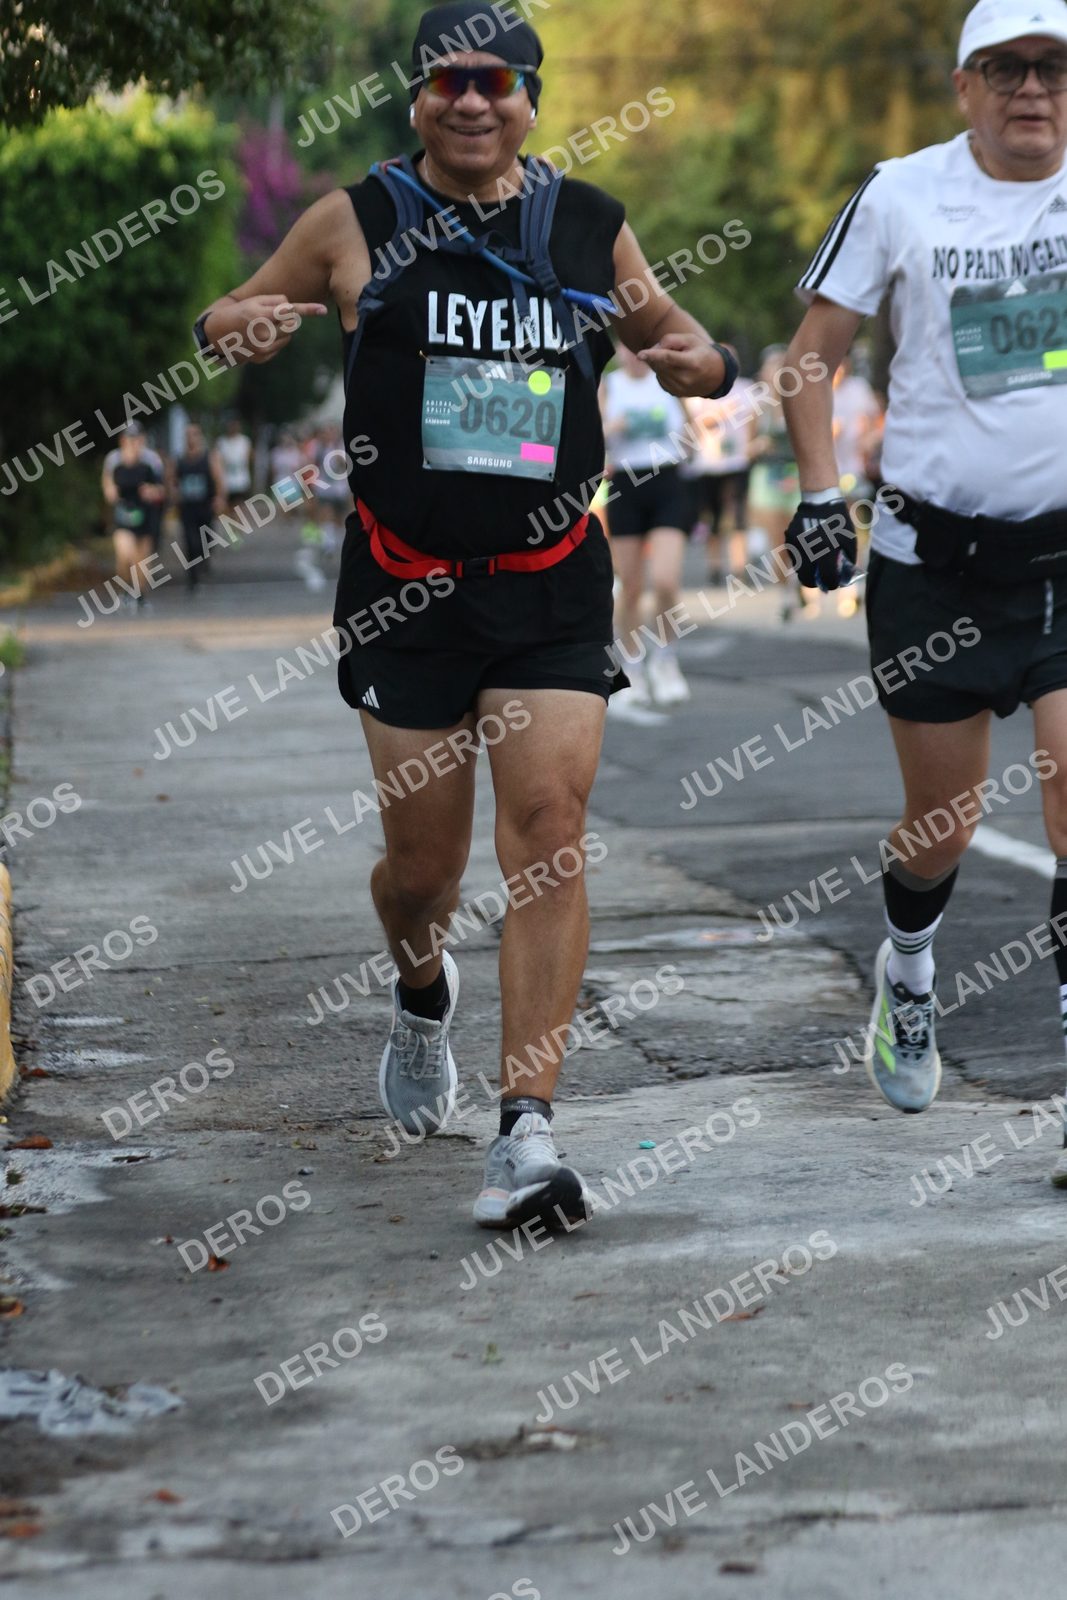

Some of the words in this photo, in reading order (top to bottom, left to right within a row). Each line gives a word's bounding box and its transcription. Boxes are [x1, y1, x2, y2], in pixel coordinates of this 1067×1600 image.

[932, 246, 959, 279] NO
[964, 247, 1006, 279] PAIN
[428, 291, 569, 350] LEYEND
[990, 304, 1067, 355] 062
[1006, 370, 1053, 385] SAMSUNG
[459, 393, 556, 442] 0620
[467, 456, 512, 467] SAMSUNG
